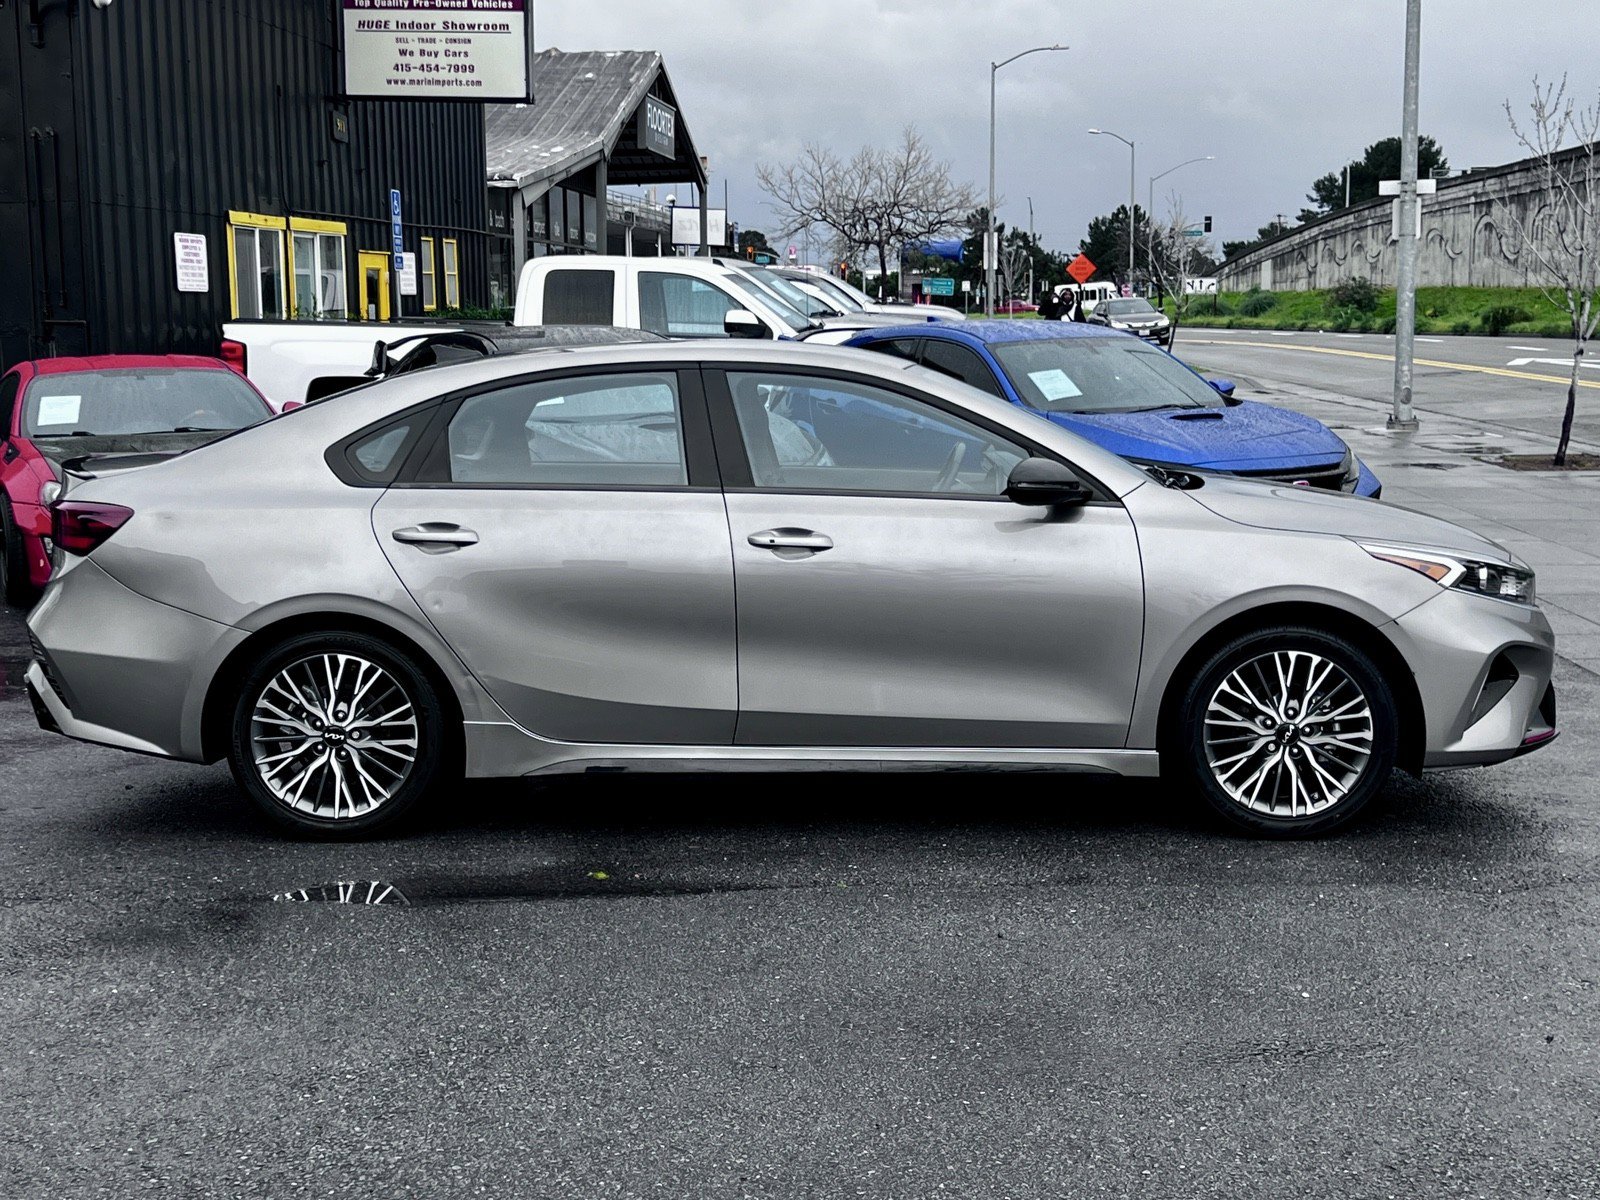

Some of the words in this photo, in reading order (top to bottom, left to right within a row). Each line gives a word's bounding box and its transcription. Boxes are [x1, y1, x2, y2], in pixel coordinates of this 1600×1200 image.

[354, 0, 370, 8] Top
[374, 0, 409, 9] Quality
[413, 0, 468, 8] Pre-Owned
[472, 0, 513, 9] Vehicles
[357, 20, 390, 30] HUGE
[395, 20, 436, 31] Indoor
[442, 20, 510, 31] Showroom
[398, 49, 414, 57] We
[419, 49, 439, 59] Buy
[444, 49, 469, 58] Cars
[393, 63, 475, 73] 415-454-7999
[386, 78, 482, 87] www.marinimports.com
